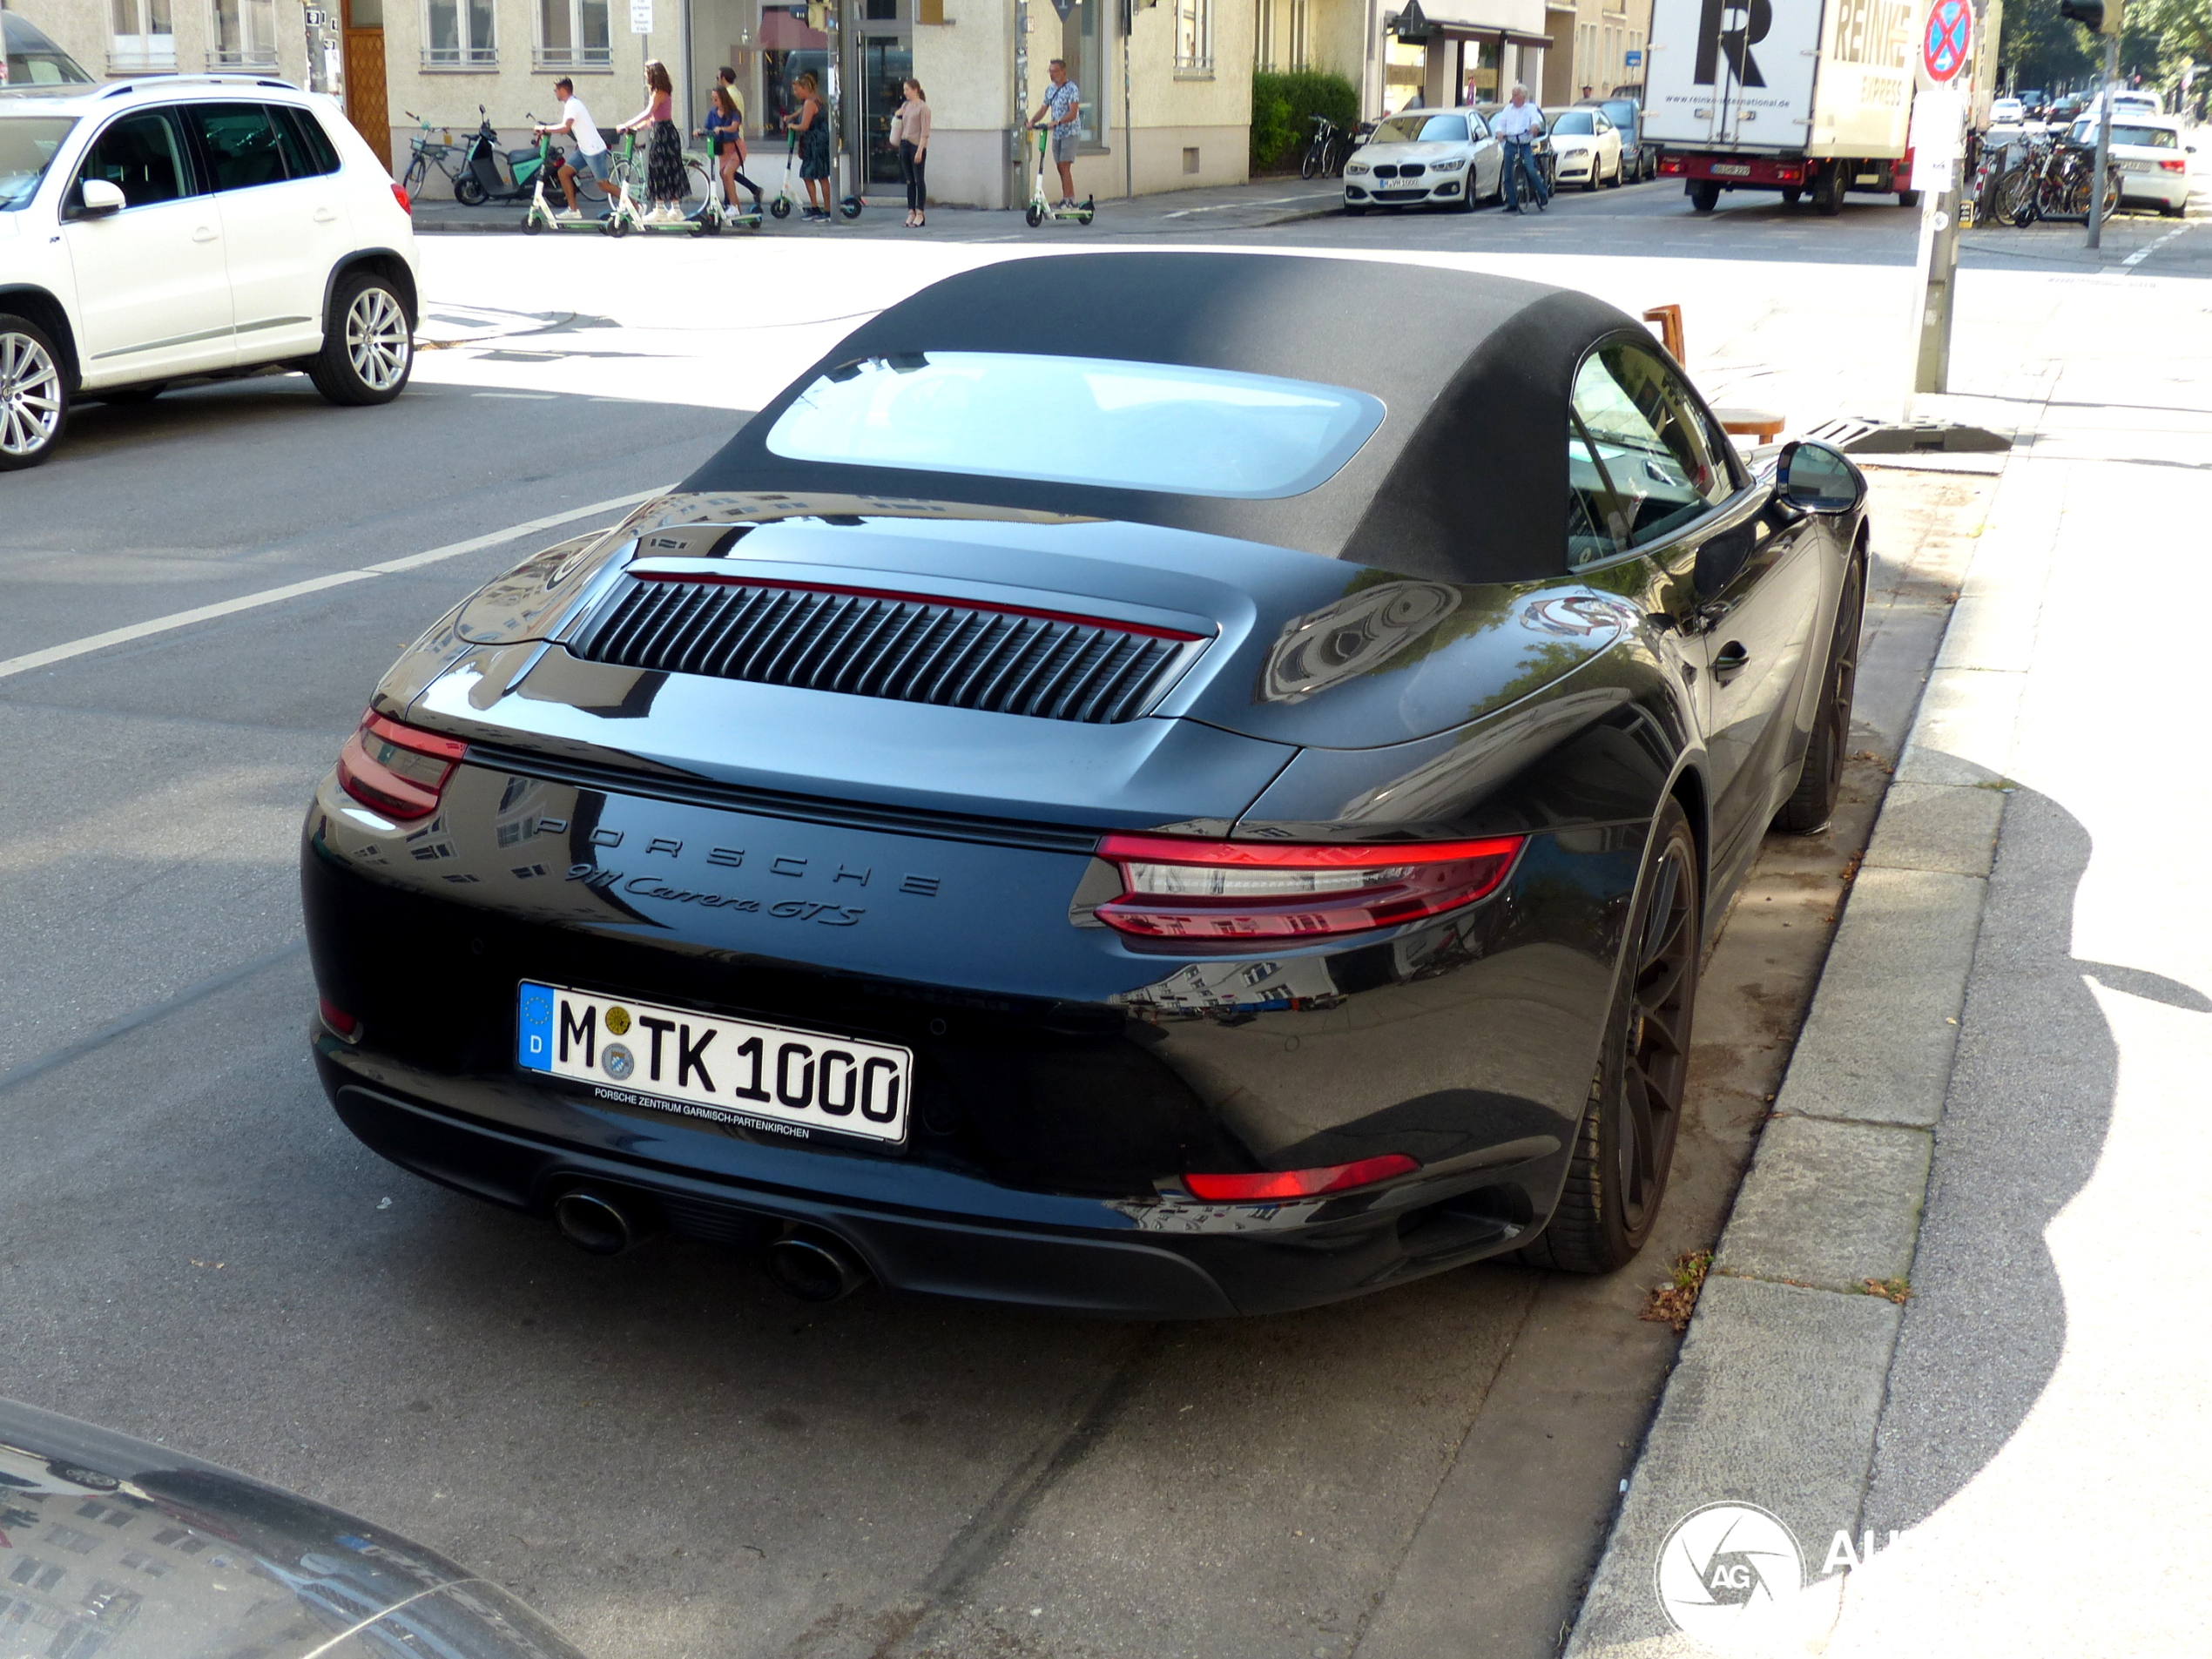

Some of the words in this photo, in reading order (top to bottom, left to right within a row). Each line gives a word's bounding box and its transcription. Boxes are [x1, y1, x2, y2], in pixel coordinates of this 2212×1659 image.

[1694, 0, 1772, 87] R
[1833, 0, 1911, 68] REINKE
[1861, 76, 1902, 106] EXPRESS
[534, 817, 940, 896] PORSCHE
[565, 863, 624, 888] 911
[624, 876, 760, 913] Carrera
[767, 900, 866, 926] GTS
[530, 1035, 542, 1053] D
[560, 1000, 597, 1068] M
[639, 1015, 718, 1092] TK
[736, 1036, 900, 1123] 1000
[595, 1088, 637, 1104] PORSCHE
[638, 1096, 681, 1113] ZENTRUM
[683, 1105, 810, 1139] GARMISCH-PARTENKIRCHEN
